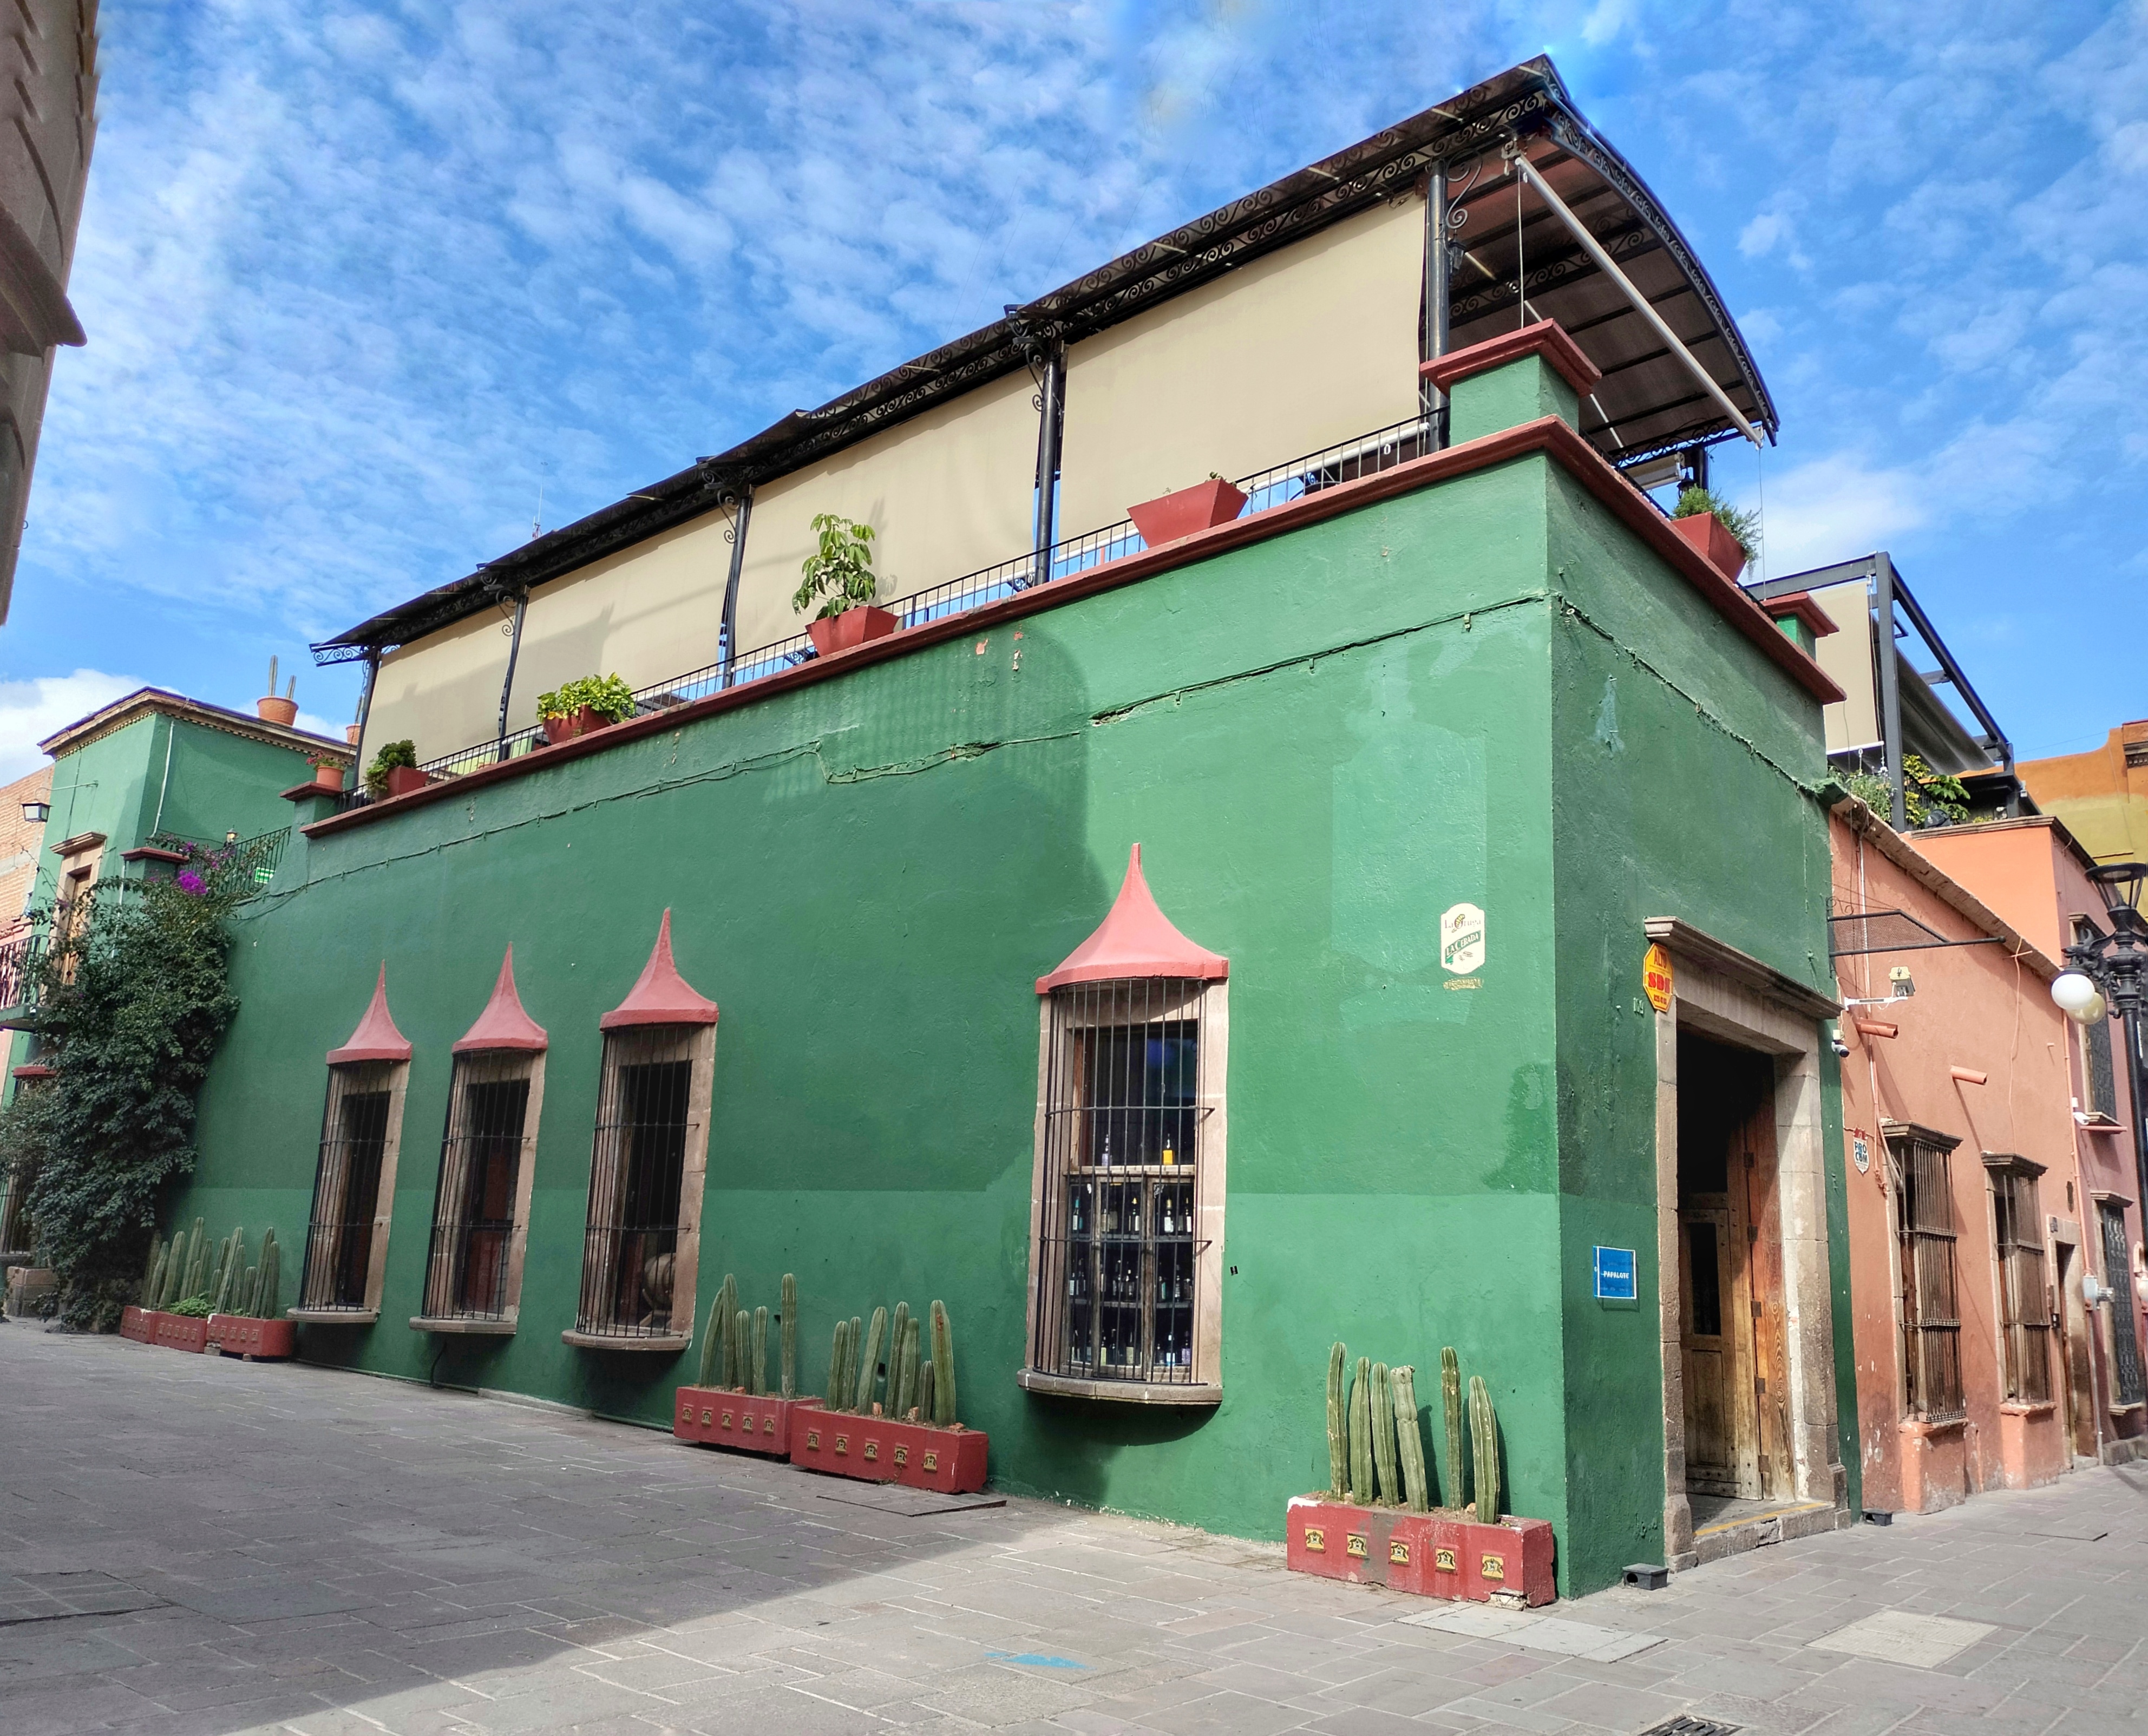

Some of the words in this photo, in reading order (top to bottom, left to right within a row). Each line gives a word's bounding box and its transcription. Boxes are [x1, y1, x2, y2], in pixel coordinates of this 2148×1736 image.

[1446, 945, 1456, 957] LA
[1455, 932, 1479, 951] CEBADA
[1654, 949, 1667, 969] ALTO
[1603, 1270, 1629, 1279] PAPALOTE
